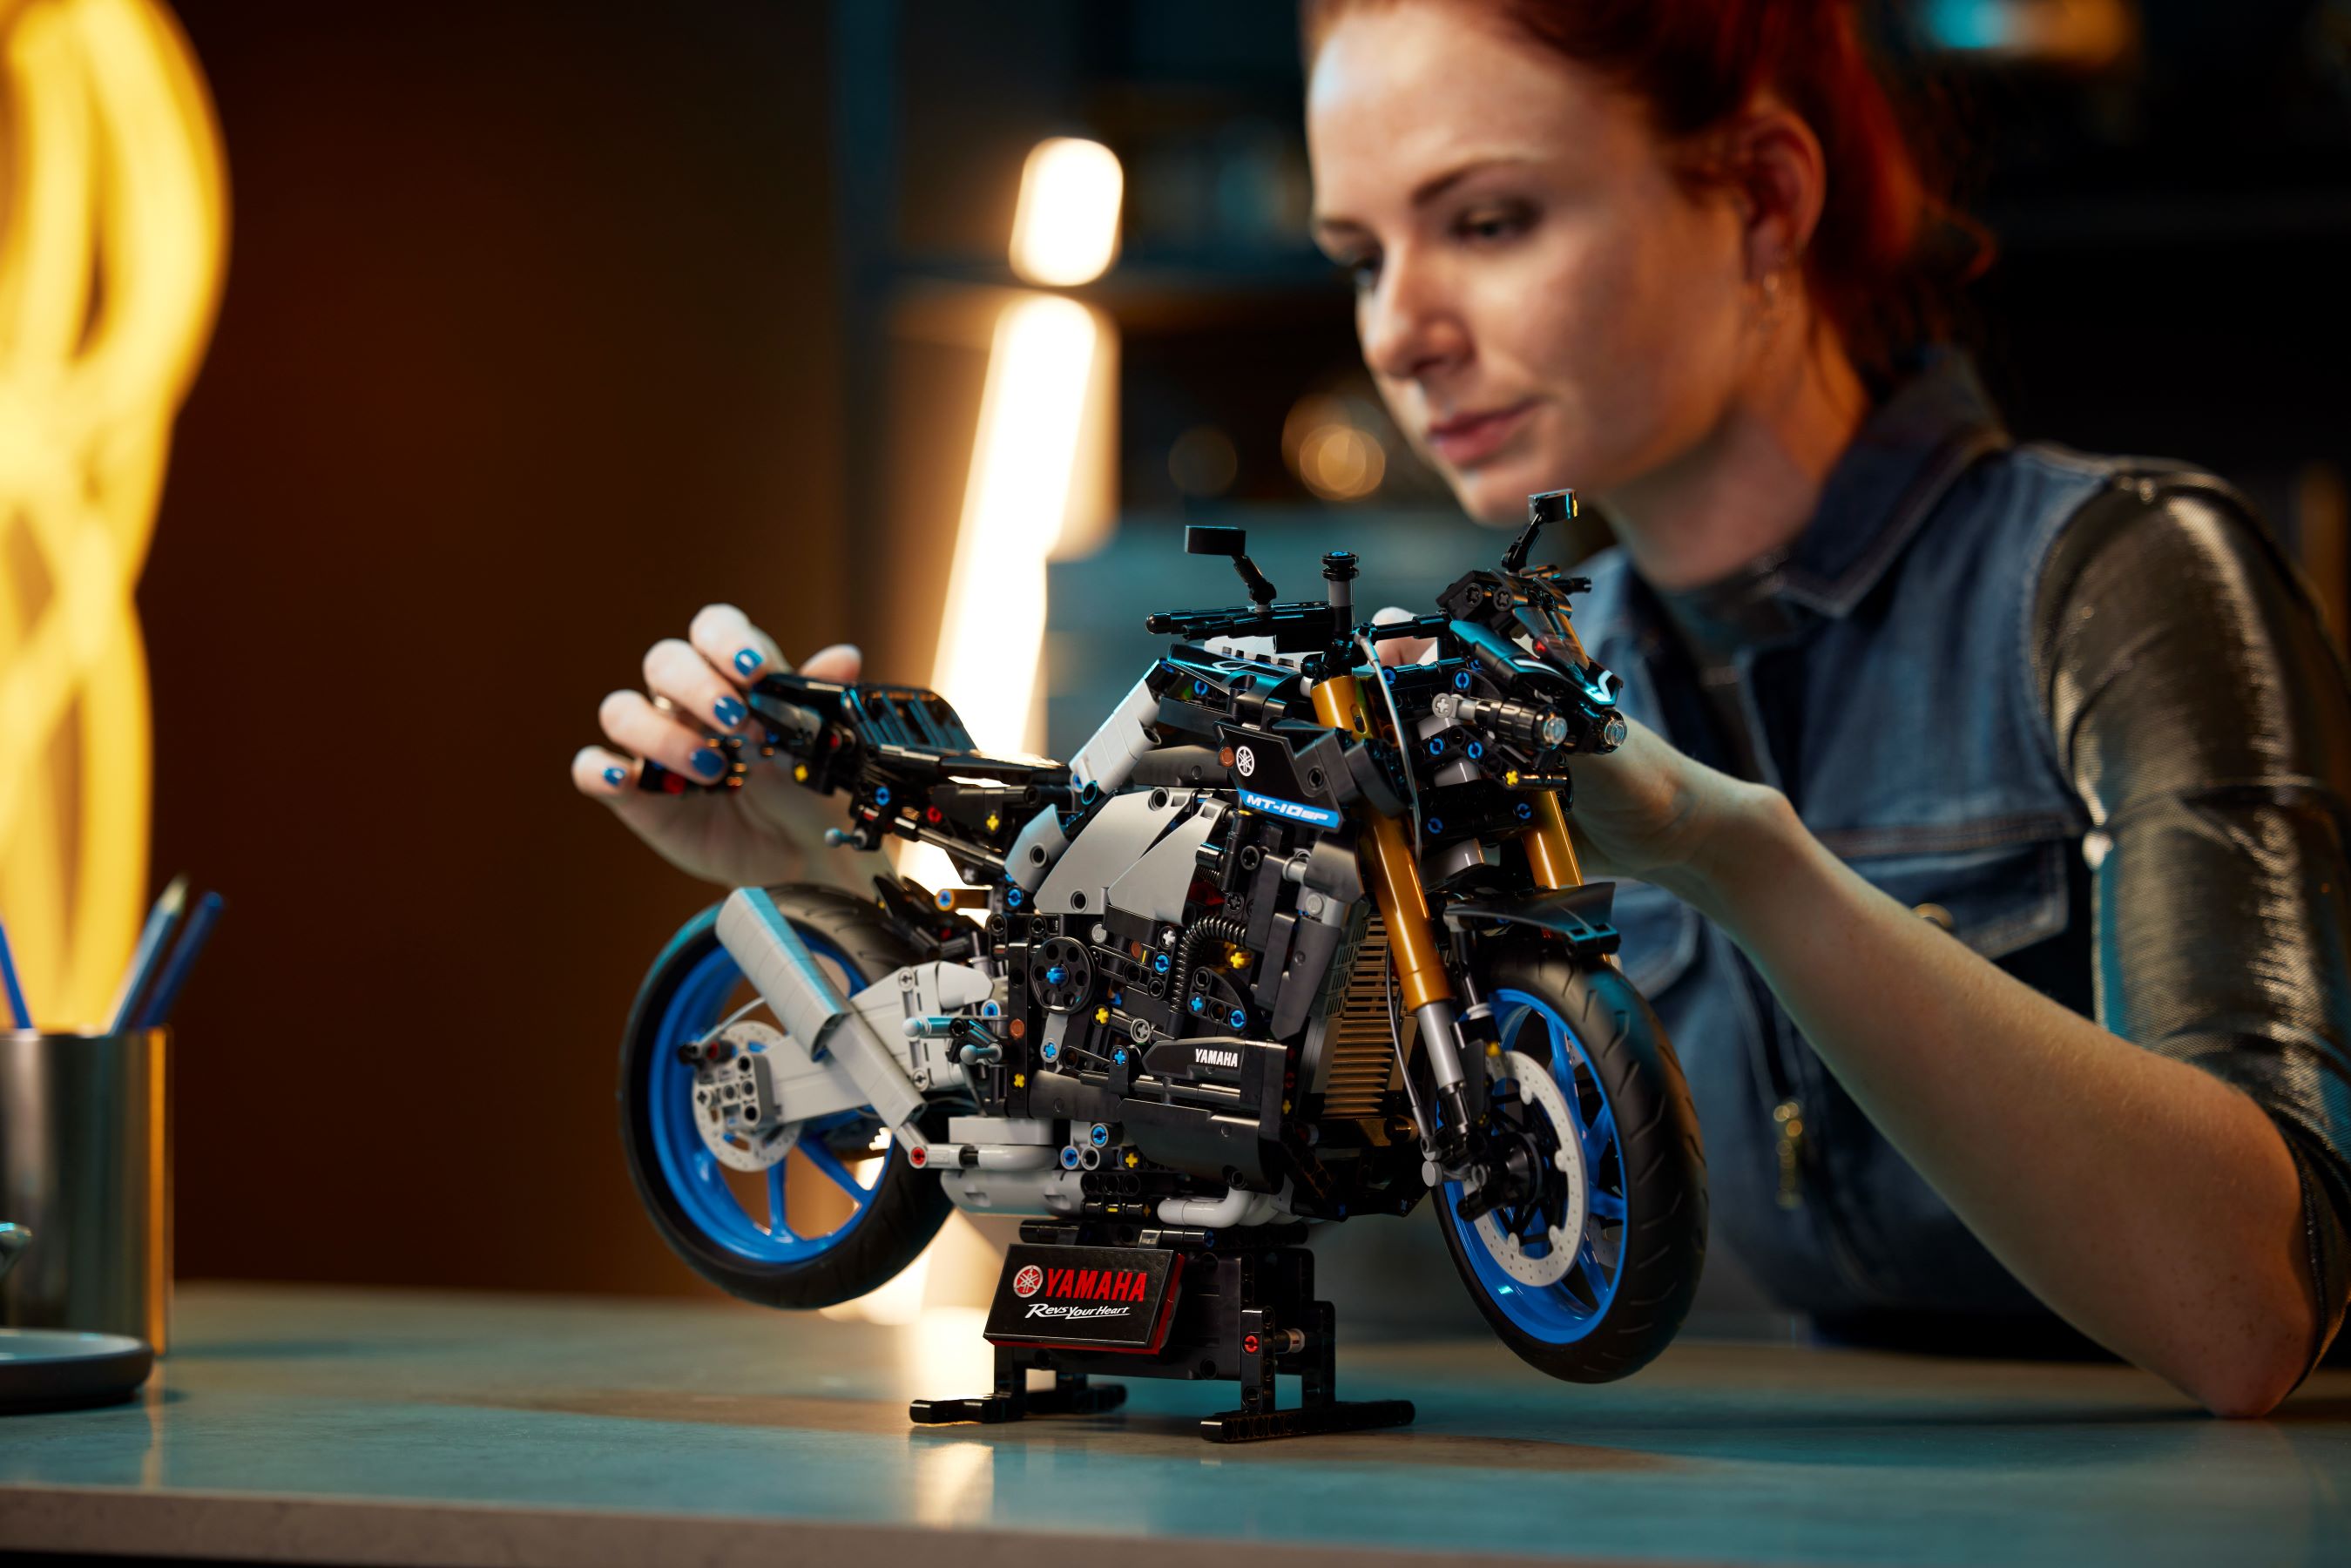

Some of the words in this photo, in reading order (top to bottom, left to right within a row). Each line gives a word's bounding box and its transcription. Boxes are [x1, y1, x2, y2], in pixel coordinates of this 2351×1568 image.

[1195, 1048, 1239, 1068] YAMAHA
[1045, 1267, 1147, 1302] YAMAHA
[1024, 1303, 1069, 1318] Revs
[1065, 1306, 1098, 1320] Your
[1096, 1306, 1130, 1316] Heart
